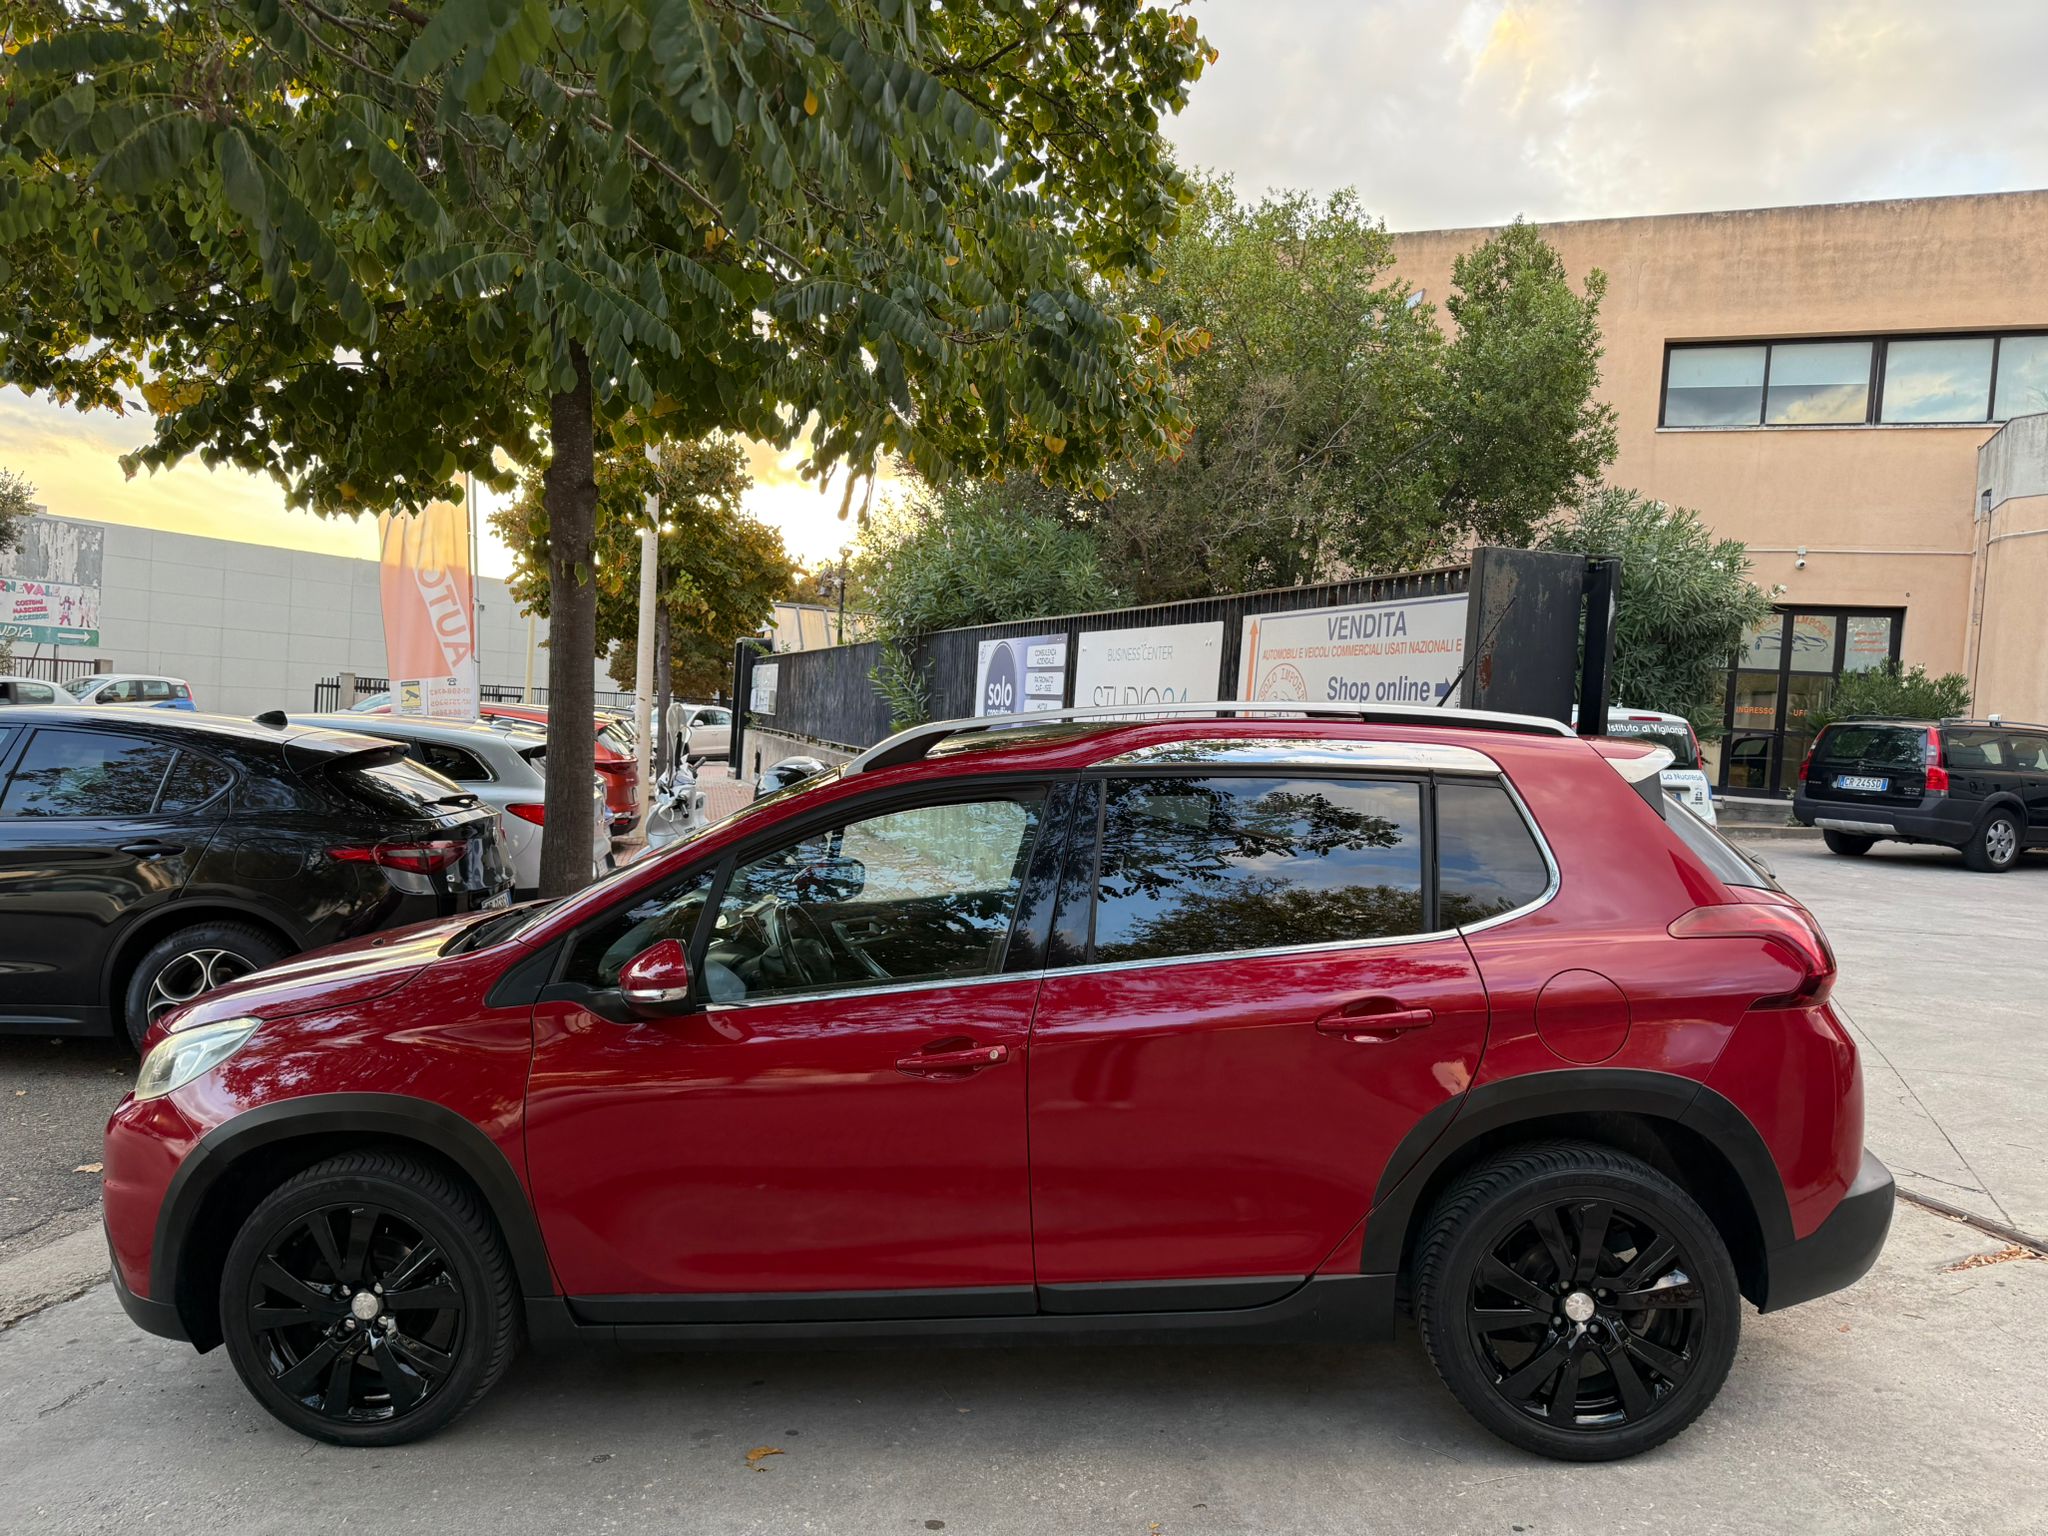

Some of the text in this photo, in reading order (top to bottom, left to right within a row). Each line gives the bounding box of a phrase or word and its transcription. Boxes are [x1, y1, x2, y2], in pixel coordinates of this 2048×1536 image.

[1327, 610, 1407, 641] VENDITA
[1107, 645, 1173, 661] BUSINESS CENTER
[1263, 648, 1297, 660] AUTOMOBILI
[1305, 646, 1329, 658] VEICOLI
[1332, 643, 1382, 657] COMMERCIALI
[1385, 641, 1407, 655] USATI
[1409, 639, 1453, 654] NAZIONALI
[1456, 638, 1462, 652] E
[988, 675, 1012, 707] solo
[1327, 675, 1430, 703] Shop online
[1735, 706, 1775, 715] INGRESSO
[1607, 723, 1688, 736] Istituto di Vigilanza
